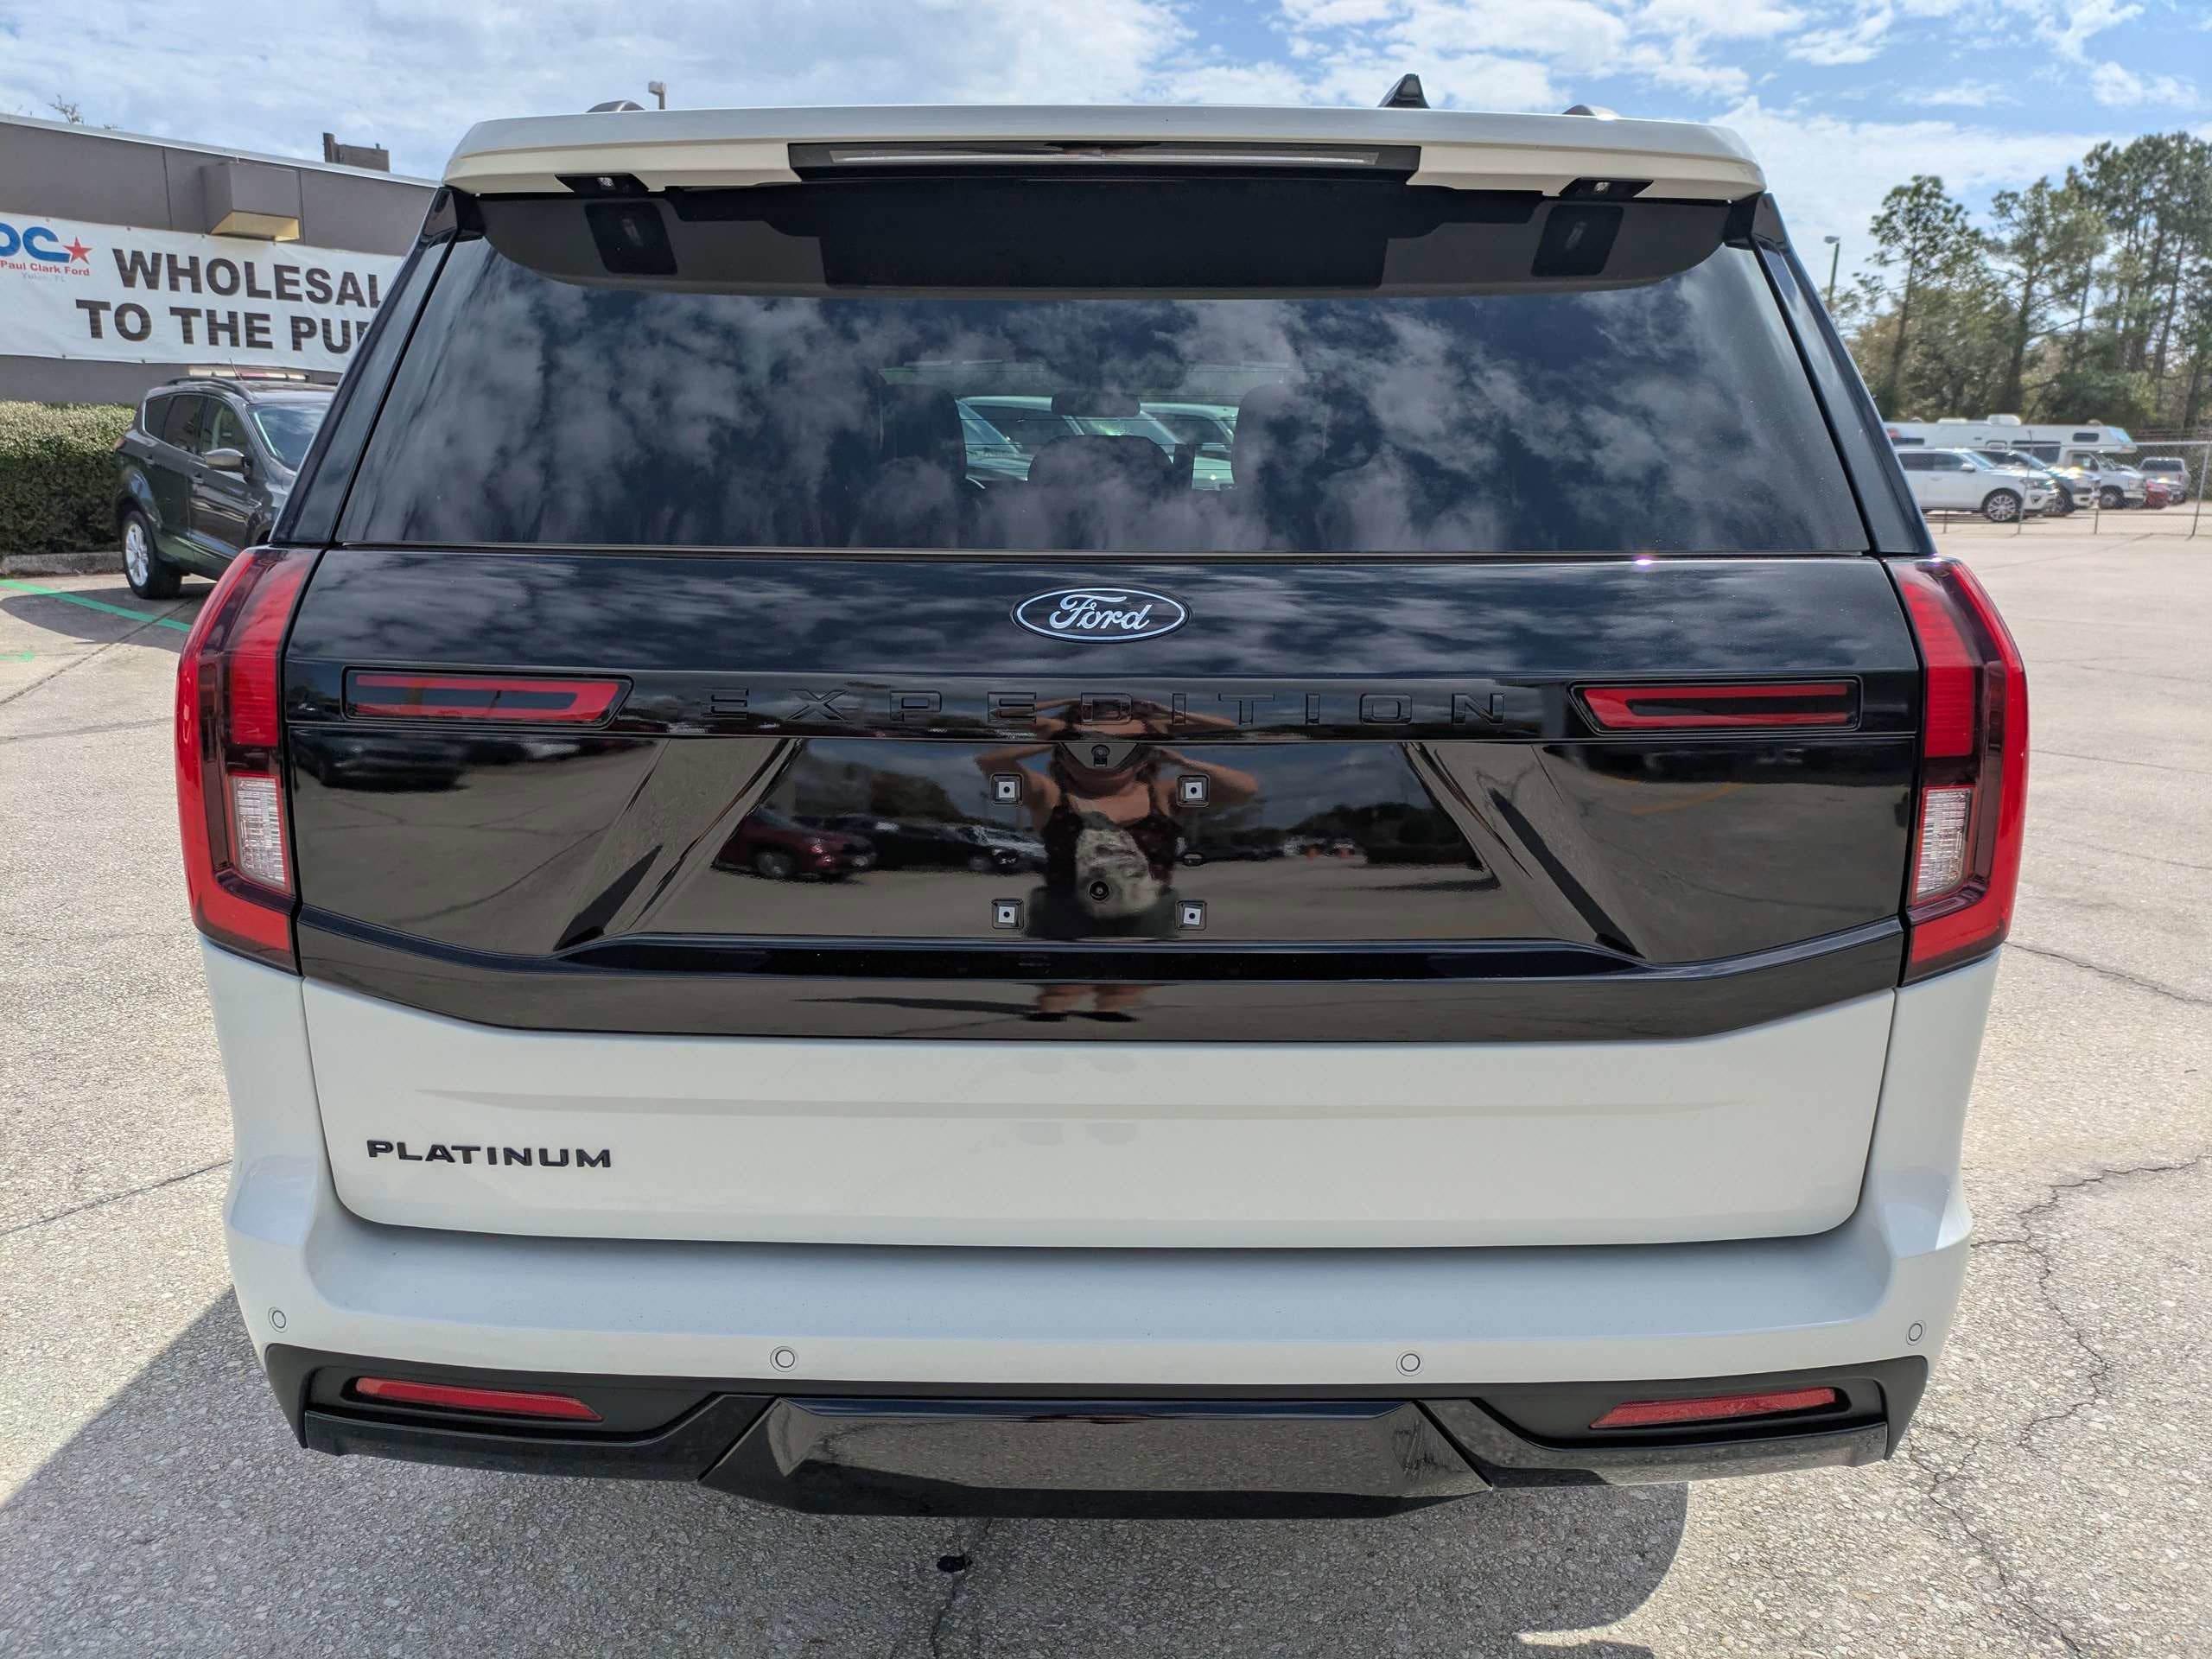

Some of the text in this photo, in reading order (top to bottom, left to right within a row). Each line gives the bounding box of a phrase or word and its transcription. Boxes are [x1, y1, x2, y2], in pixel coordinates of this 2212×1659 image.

[0, 260, 91, 276] Paul Clark Ford
[76, 299, 152, 341] TO
[169, 307, 273, 349] THE
[1049, 594, 1153, 630] Ford
[701, 687, 1505, 726] EXPEDITION
[366, 1140, 612, 1168] PLATINUM
